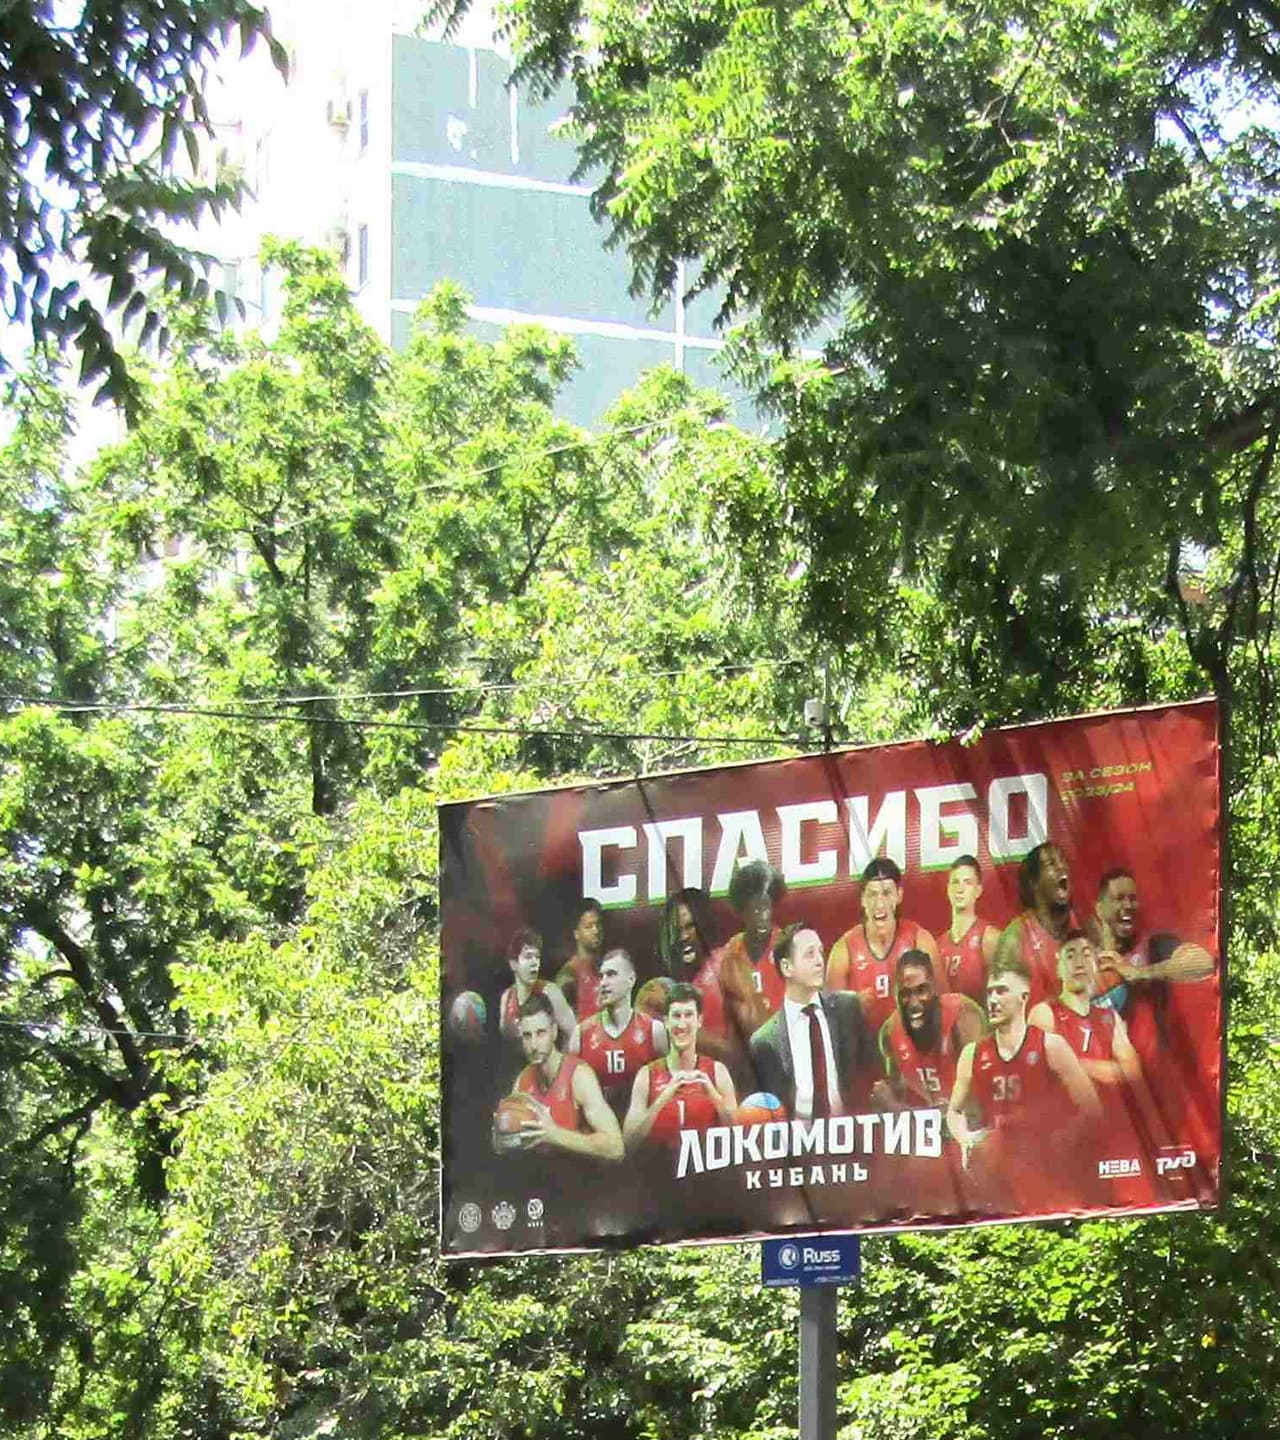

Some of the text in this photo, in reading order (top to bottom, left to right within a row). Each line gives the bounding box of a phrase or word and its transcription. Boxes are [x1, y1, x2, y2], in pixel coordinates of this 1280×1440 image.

[577, 773, 1049, 906] СПАСИБО
[876, 976, 889, 998] 9
[605, 1050, 625, 1074] 16
[916, 1067, 941, 1092] 15
[676, 1108, 942, 1179] ЛОКОМОТИВ
[746, 1162, 869, 1190] КУБАНЬ
[1098, 1159, 1141, 1175] НЕВА
[803, 1247, 841, 1264] Russ
